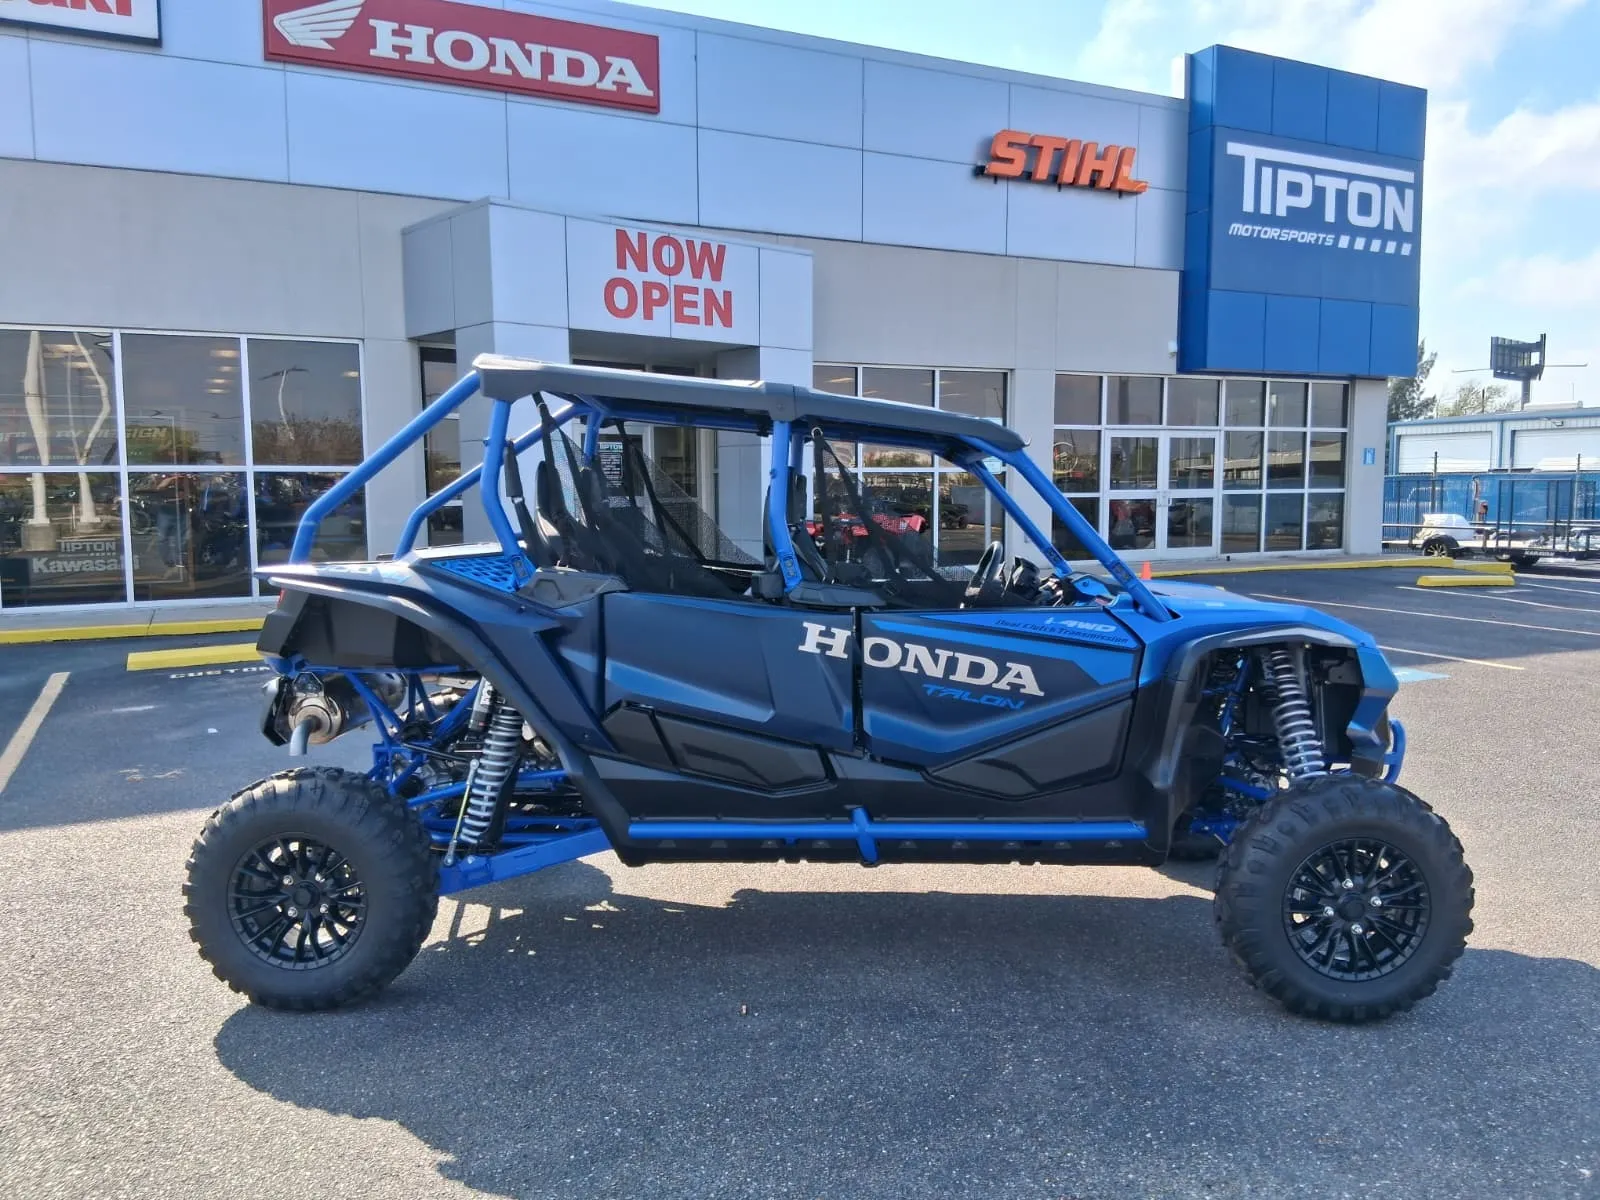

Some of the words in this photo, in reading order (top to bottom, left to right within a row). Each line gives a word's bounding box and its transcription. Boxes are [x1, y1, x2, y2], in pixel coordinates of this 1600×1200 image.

[369, 19, 654, 97] HONDA
[984, 129, 1149, 193] STIHL
[1227, 141, 1415, 233] TIPTON
[615, 228, 727, 282] NOW
[1228, 223, 1335, 246] MOTORSPORTS
[603, 277, 733, 328] OPEN
[32, 555, 140, 573] Kawasai
[56, 537, 117, 553] TIPTON
[798, 621, 1045, 697] HONDA
[922, 684, 1025, 710] TALON
